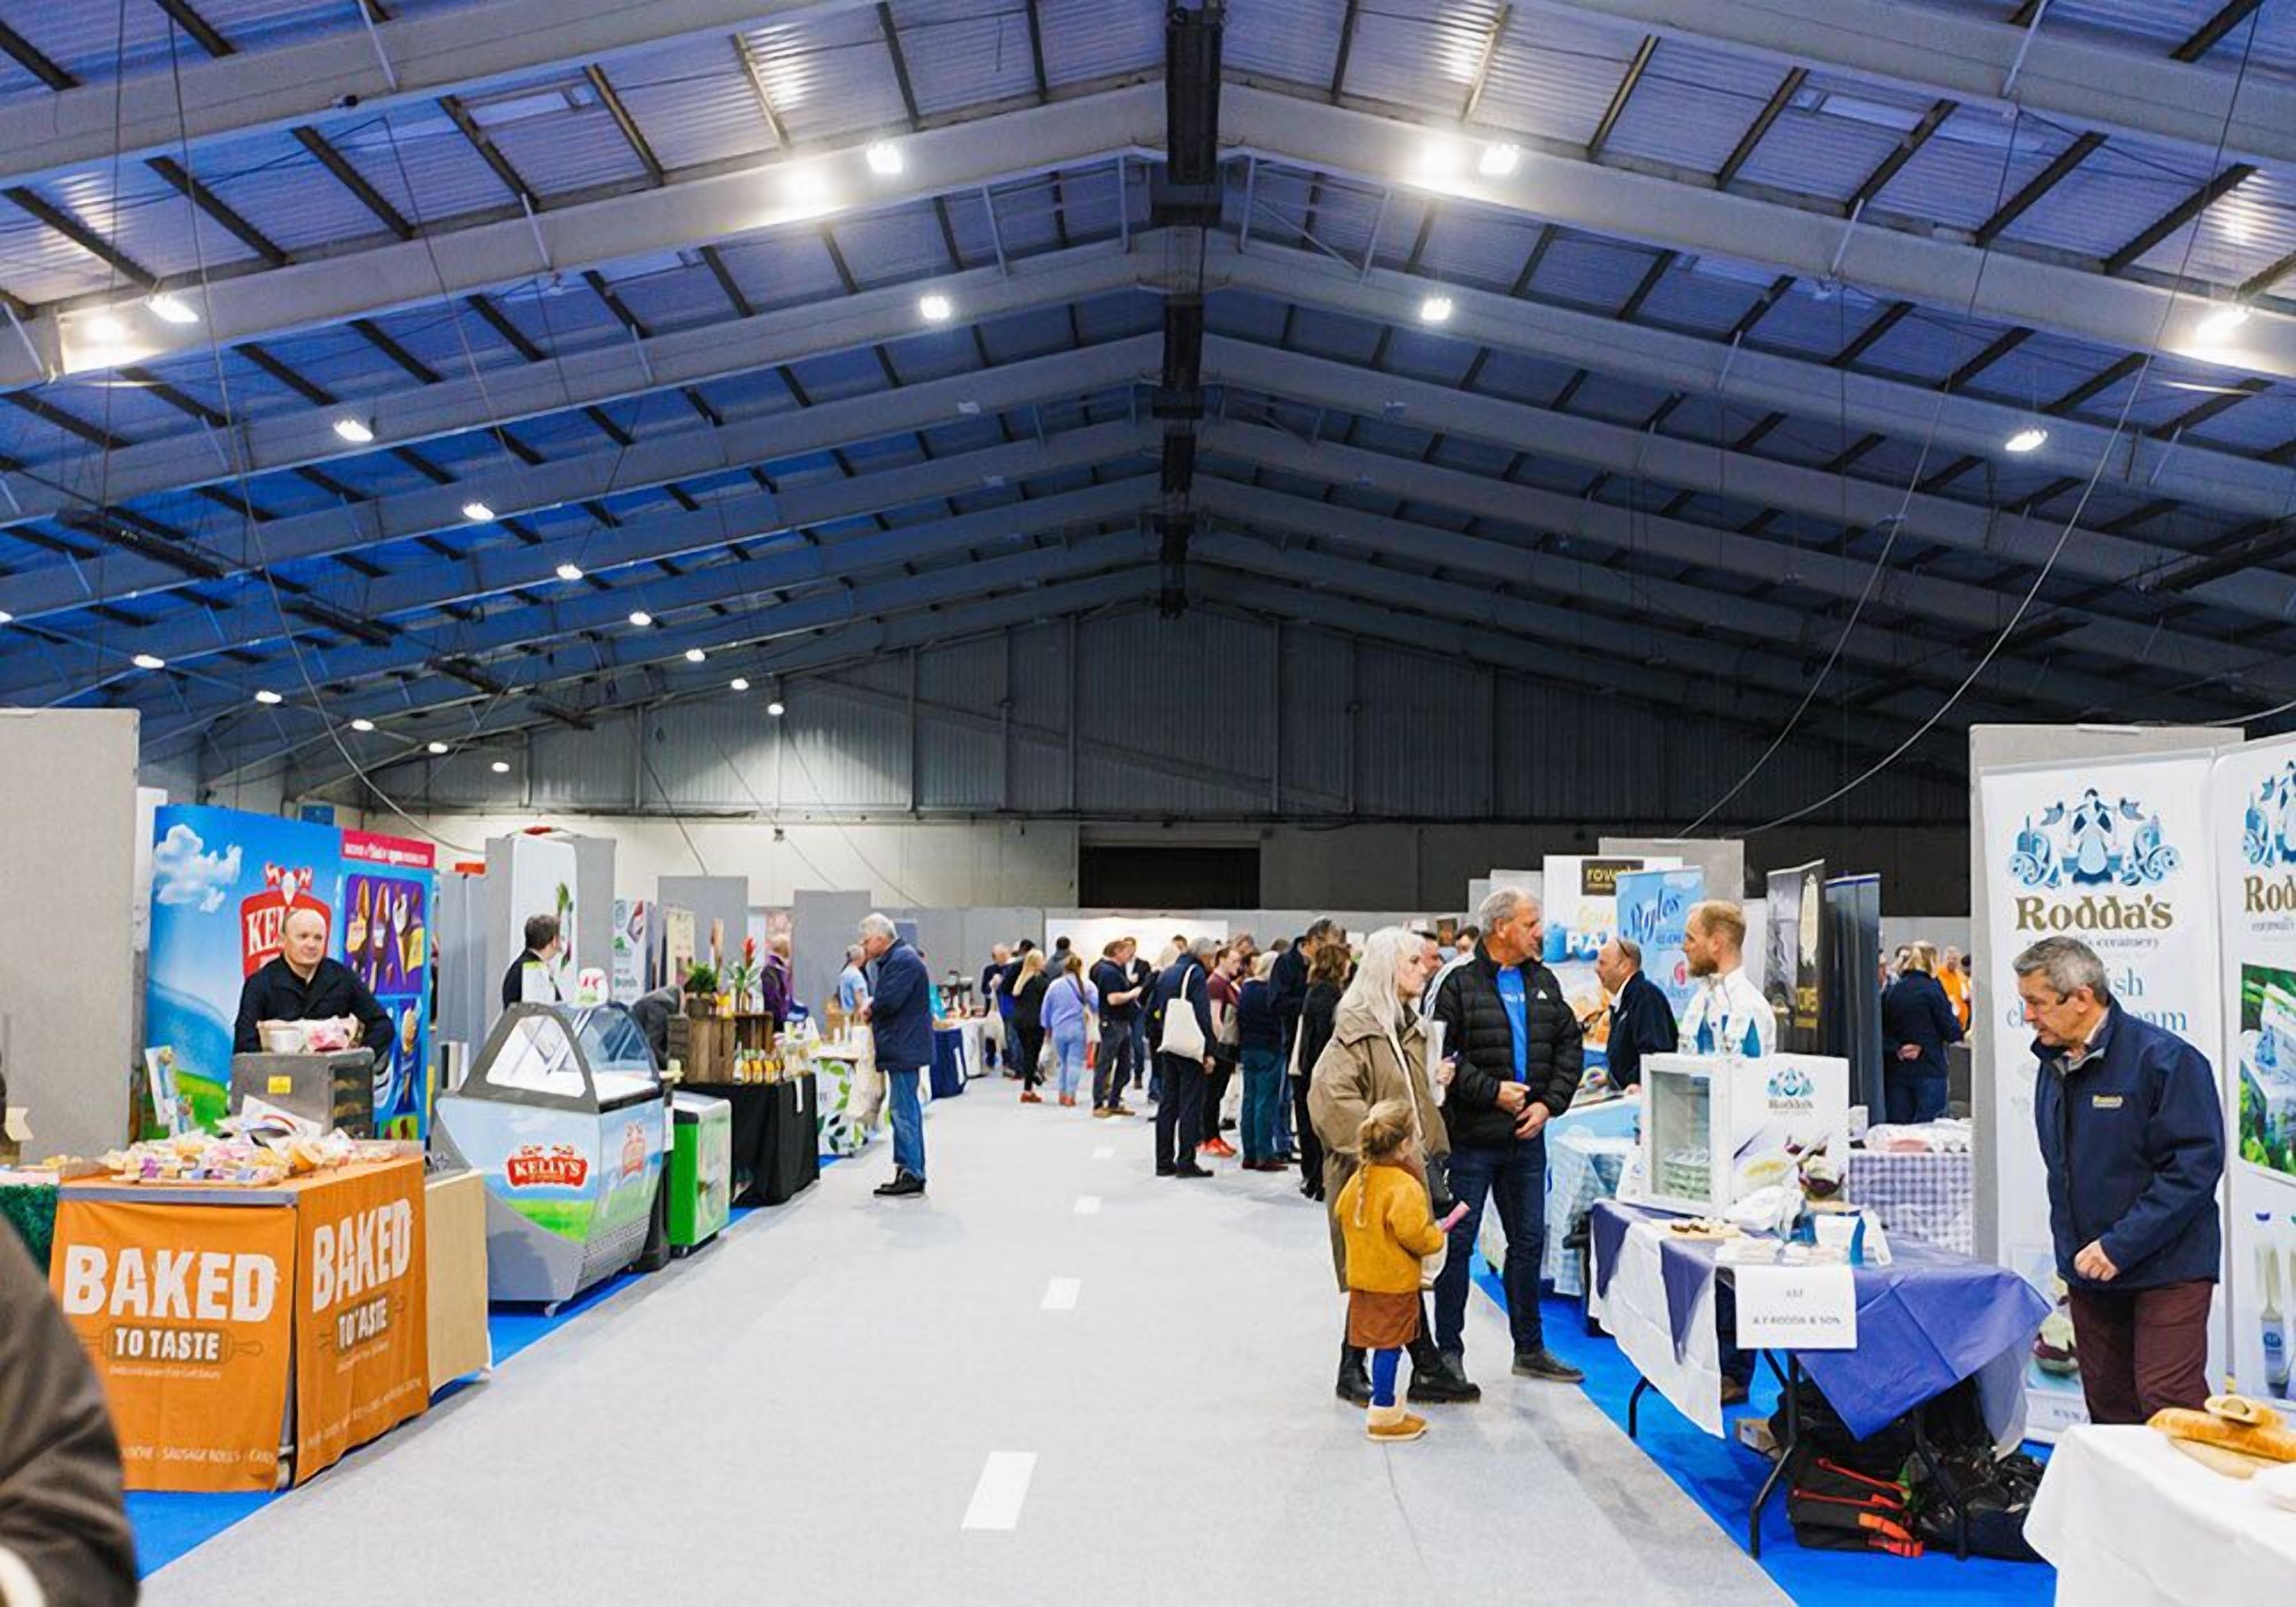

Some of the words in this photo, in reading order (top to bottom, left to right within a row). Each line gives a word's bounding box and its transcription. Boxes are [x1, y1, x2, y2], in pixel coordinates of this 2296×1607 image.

[2015, 894, 2173, 930] Rodda's
[514, 1160, 582, 1178] KELLY'S
[312, 1198, 413, 1313] BAKED
[63, 1244, 279, 1322] BAKED
[116, 1327, 144, 1356] TO
[149, 1329, 220, 1360] TASTE
[339, 1313, 355, 1349] TO
